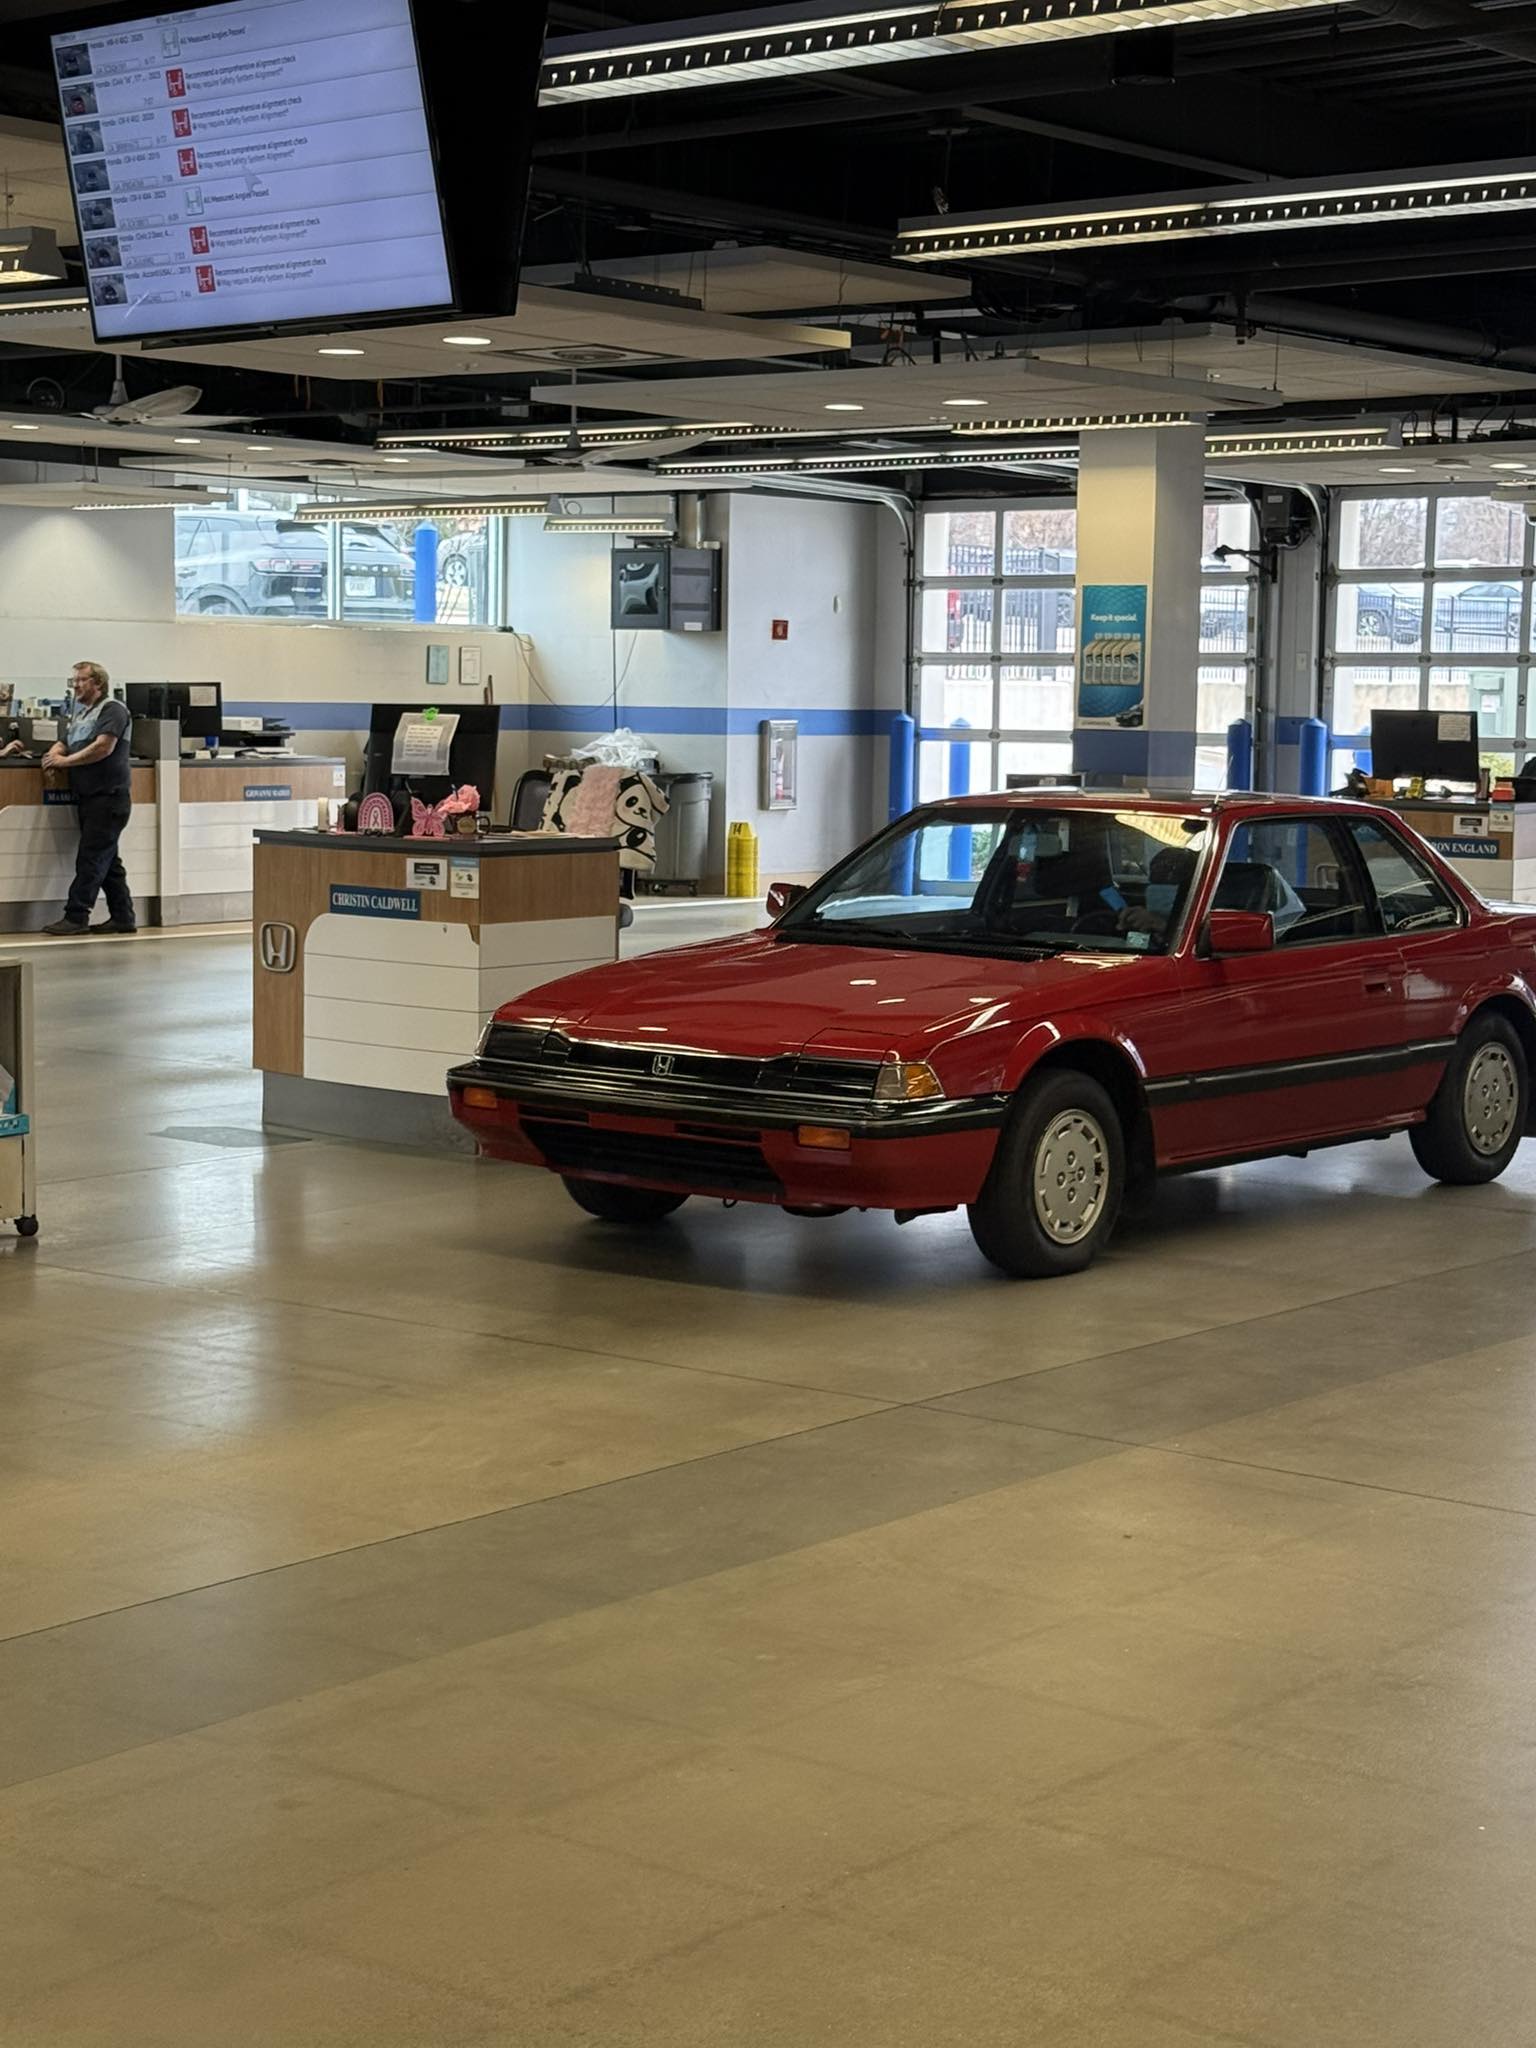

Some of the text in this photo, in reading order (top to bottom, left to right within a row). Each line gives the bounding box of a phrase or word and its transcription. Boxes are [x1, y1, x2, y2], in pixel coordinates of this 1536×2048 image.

[219, 62, 256, 75] comprehensive
[224, 103, 261, 115] comprehensive
[230, 143, 267, 155] comprehensive
[243, 223, 279, 235] comprehensive
[248, 262, 285, 274] comprehensive
[1518, 694, 1526, 706] 2
[1452, 842, 1498, 854] ENGLAND
[332, 892, 419, 912] CHRISTIN CALDWELL
